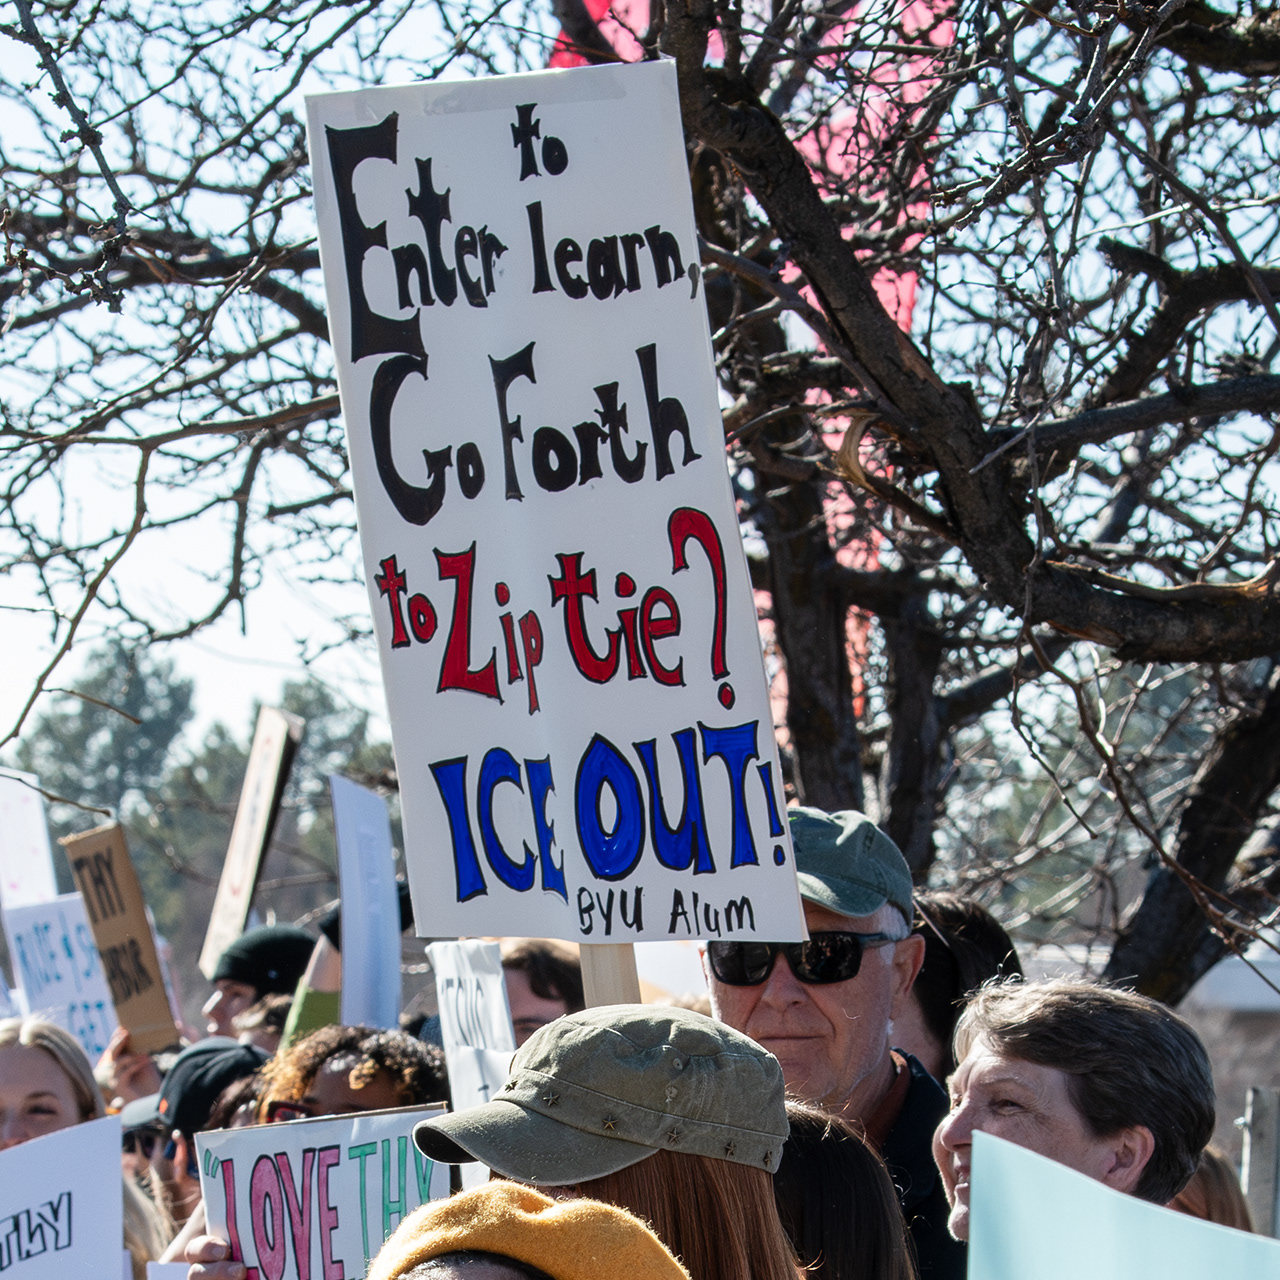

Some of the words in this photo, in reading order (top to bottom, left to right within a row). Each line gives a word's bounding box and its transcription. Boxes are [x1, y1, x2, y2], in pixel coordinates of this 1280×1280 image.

[510, 102, 569, 182] to
[324, 111, 509, 364] Enter
[526, 200, 701, 300] learn,
[370, 354, 486, 526] Go
[488, 341, 702, 502] Forth
[374, 553, 438, 650] to
[429, 746, 569, 905] ICE
[574, 720, 786, 882] OUT!
[74, 846, 125, 925] THY
[578, 886, 645, 936] BYU
[668, 889, 756, 938] Alum
